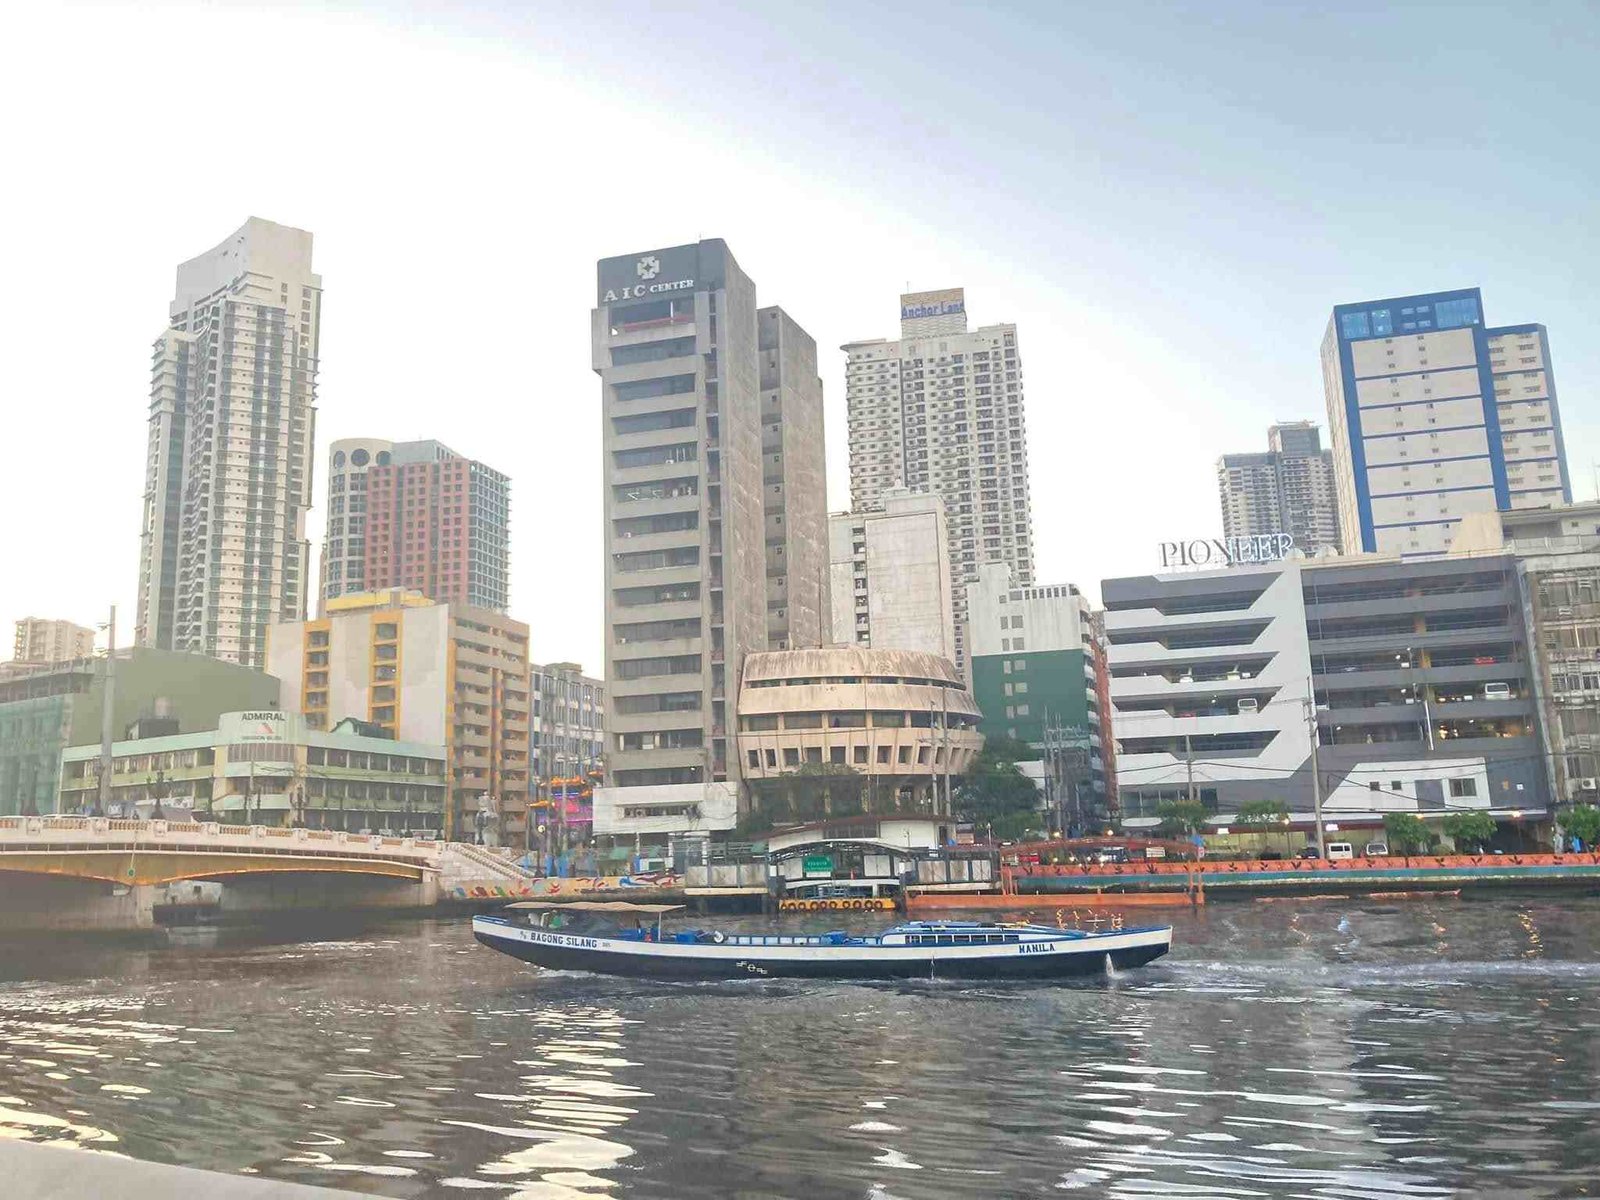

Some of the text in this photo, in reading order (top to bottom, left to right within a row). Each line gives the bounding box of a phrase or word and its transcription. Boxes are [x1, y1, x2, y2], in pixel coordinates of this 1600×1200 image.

[650, 279, 694, 293] CENTER
[902, 303, 939, 318] Anchor
[1158, 533, 1294, 567] PIONEER
[241, 712, 286, 721] ADMIRAL
[530, 932, 564, 945] BAGONG
[566, 936, 598, 948] SILANG
[1018, 943, 1056, 953] MANILA
